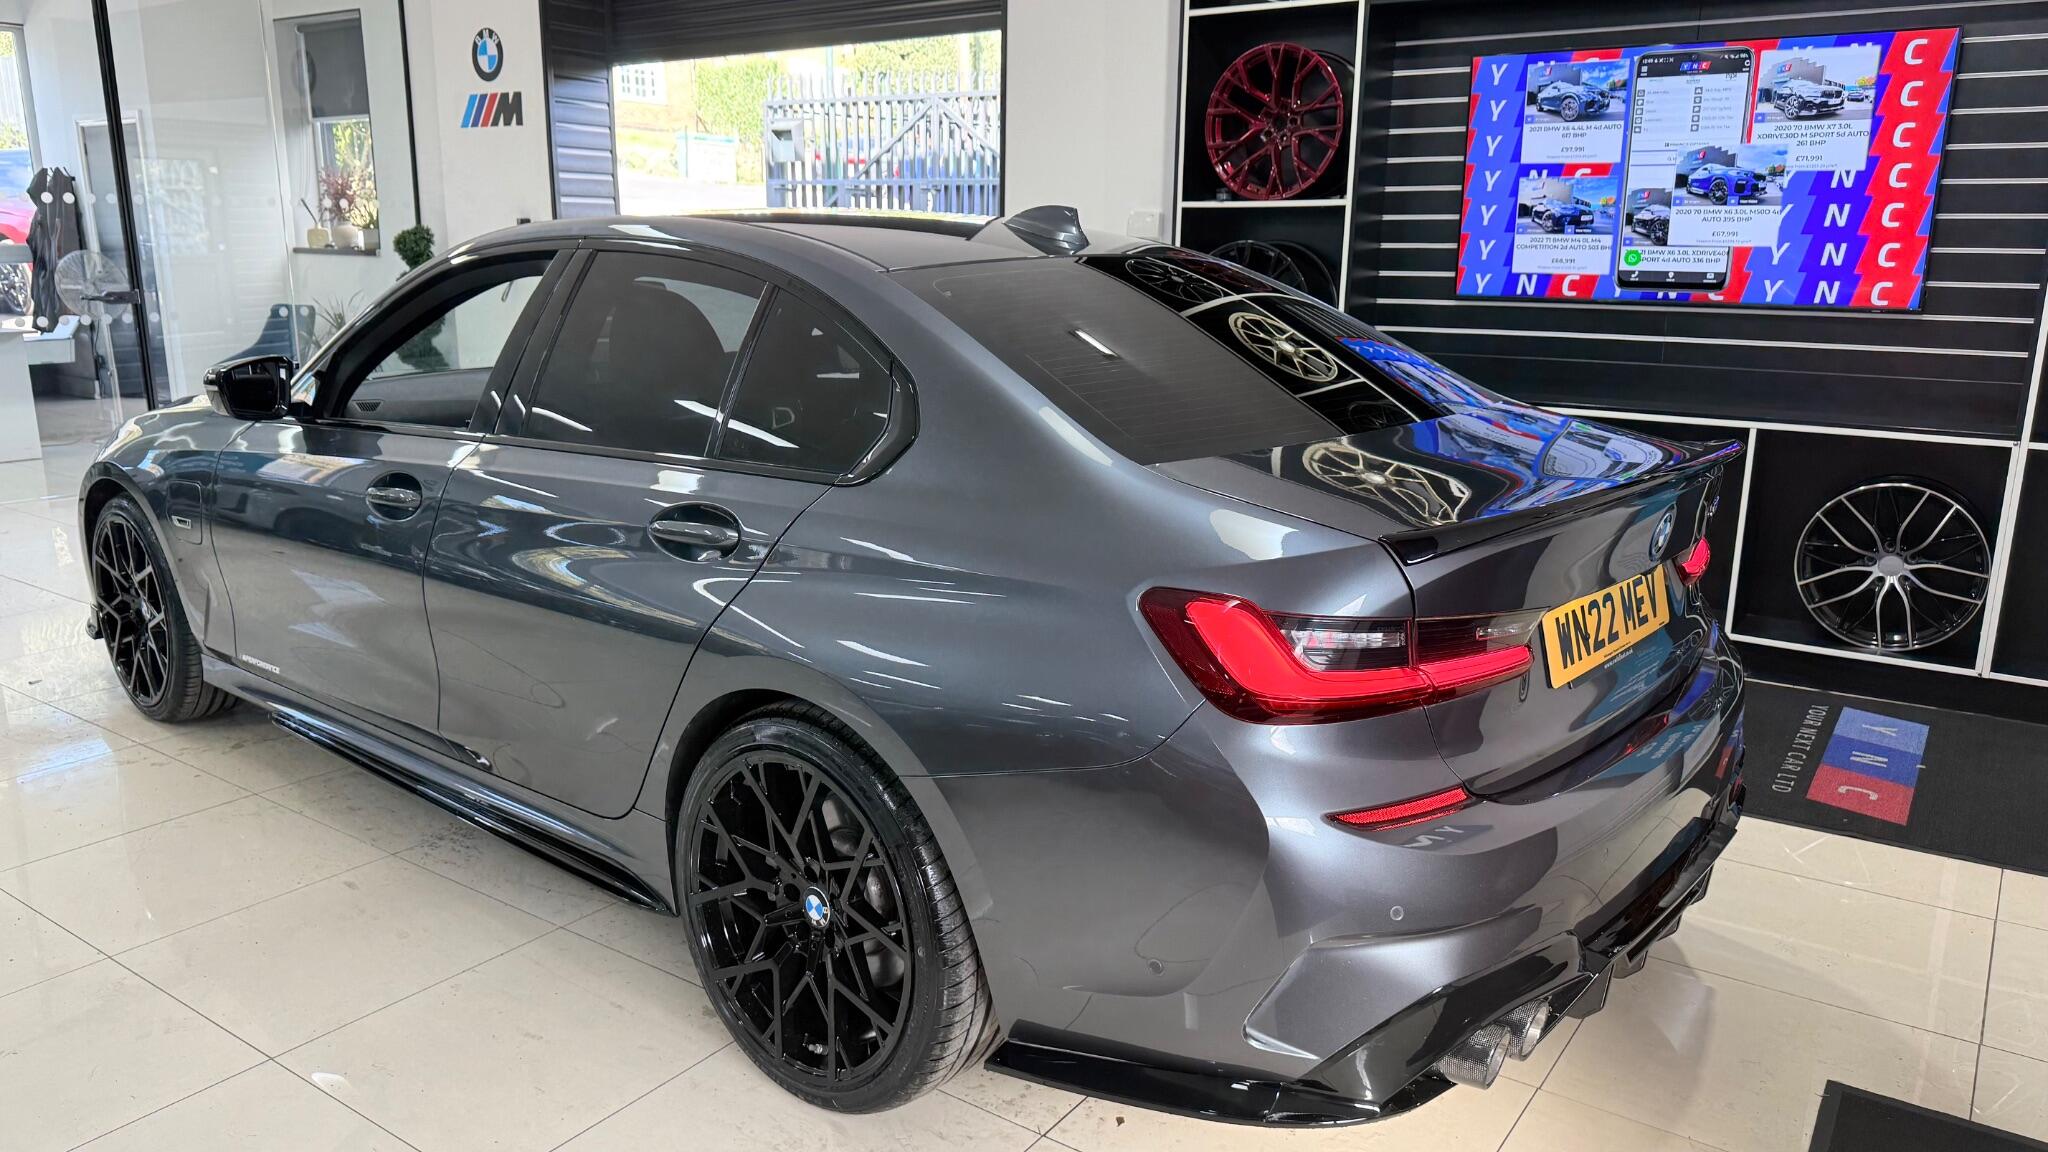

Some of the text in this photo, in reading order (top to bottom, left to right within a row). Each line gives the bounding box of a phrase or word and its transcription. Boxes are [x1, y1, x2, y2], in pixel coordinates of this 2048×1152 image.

[474, 28, 500, 46] BMW
[1904, 38, 1928, 65] C
[1491, 63, 1508, 86] Y
[1901, 80, 1924, 107] C
[1490, 99, 1507, 121] Y
[1486, 135, 1503, 157] Y
[1757, 132, 1799, 140] XDRIVE30D
[1809, 131, 1835, 139] SPORT
[1809, 139, 1827, 147] BHP
[1893, 122, 1916, 148] C
[1485, 171, 1501, 192] Y
[1889, 162, 1913, 188] C
[1481, 205, 1497, 226] Y
[1823, 203, 1851, 227] N
[1882, 203, 1905, 228] C
[1480, 240, 1496, 260] Y
[1820, 242, 1848, 267] N
[1878, 242, 1901, 268] C
[1475, 273, 1894, 306] Y N C Y N C
[1555, 571, 1657, 670] WN22 MEV
[1772, 705, 1830, 794] YOUR NEXT CAR LTD
